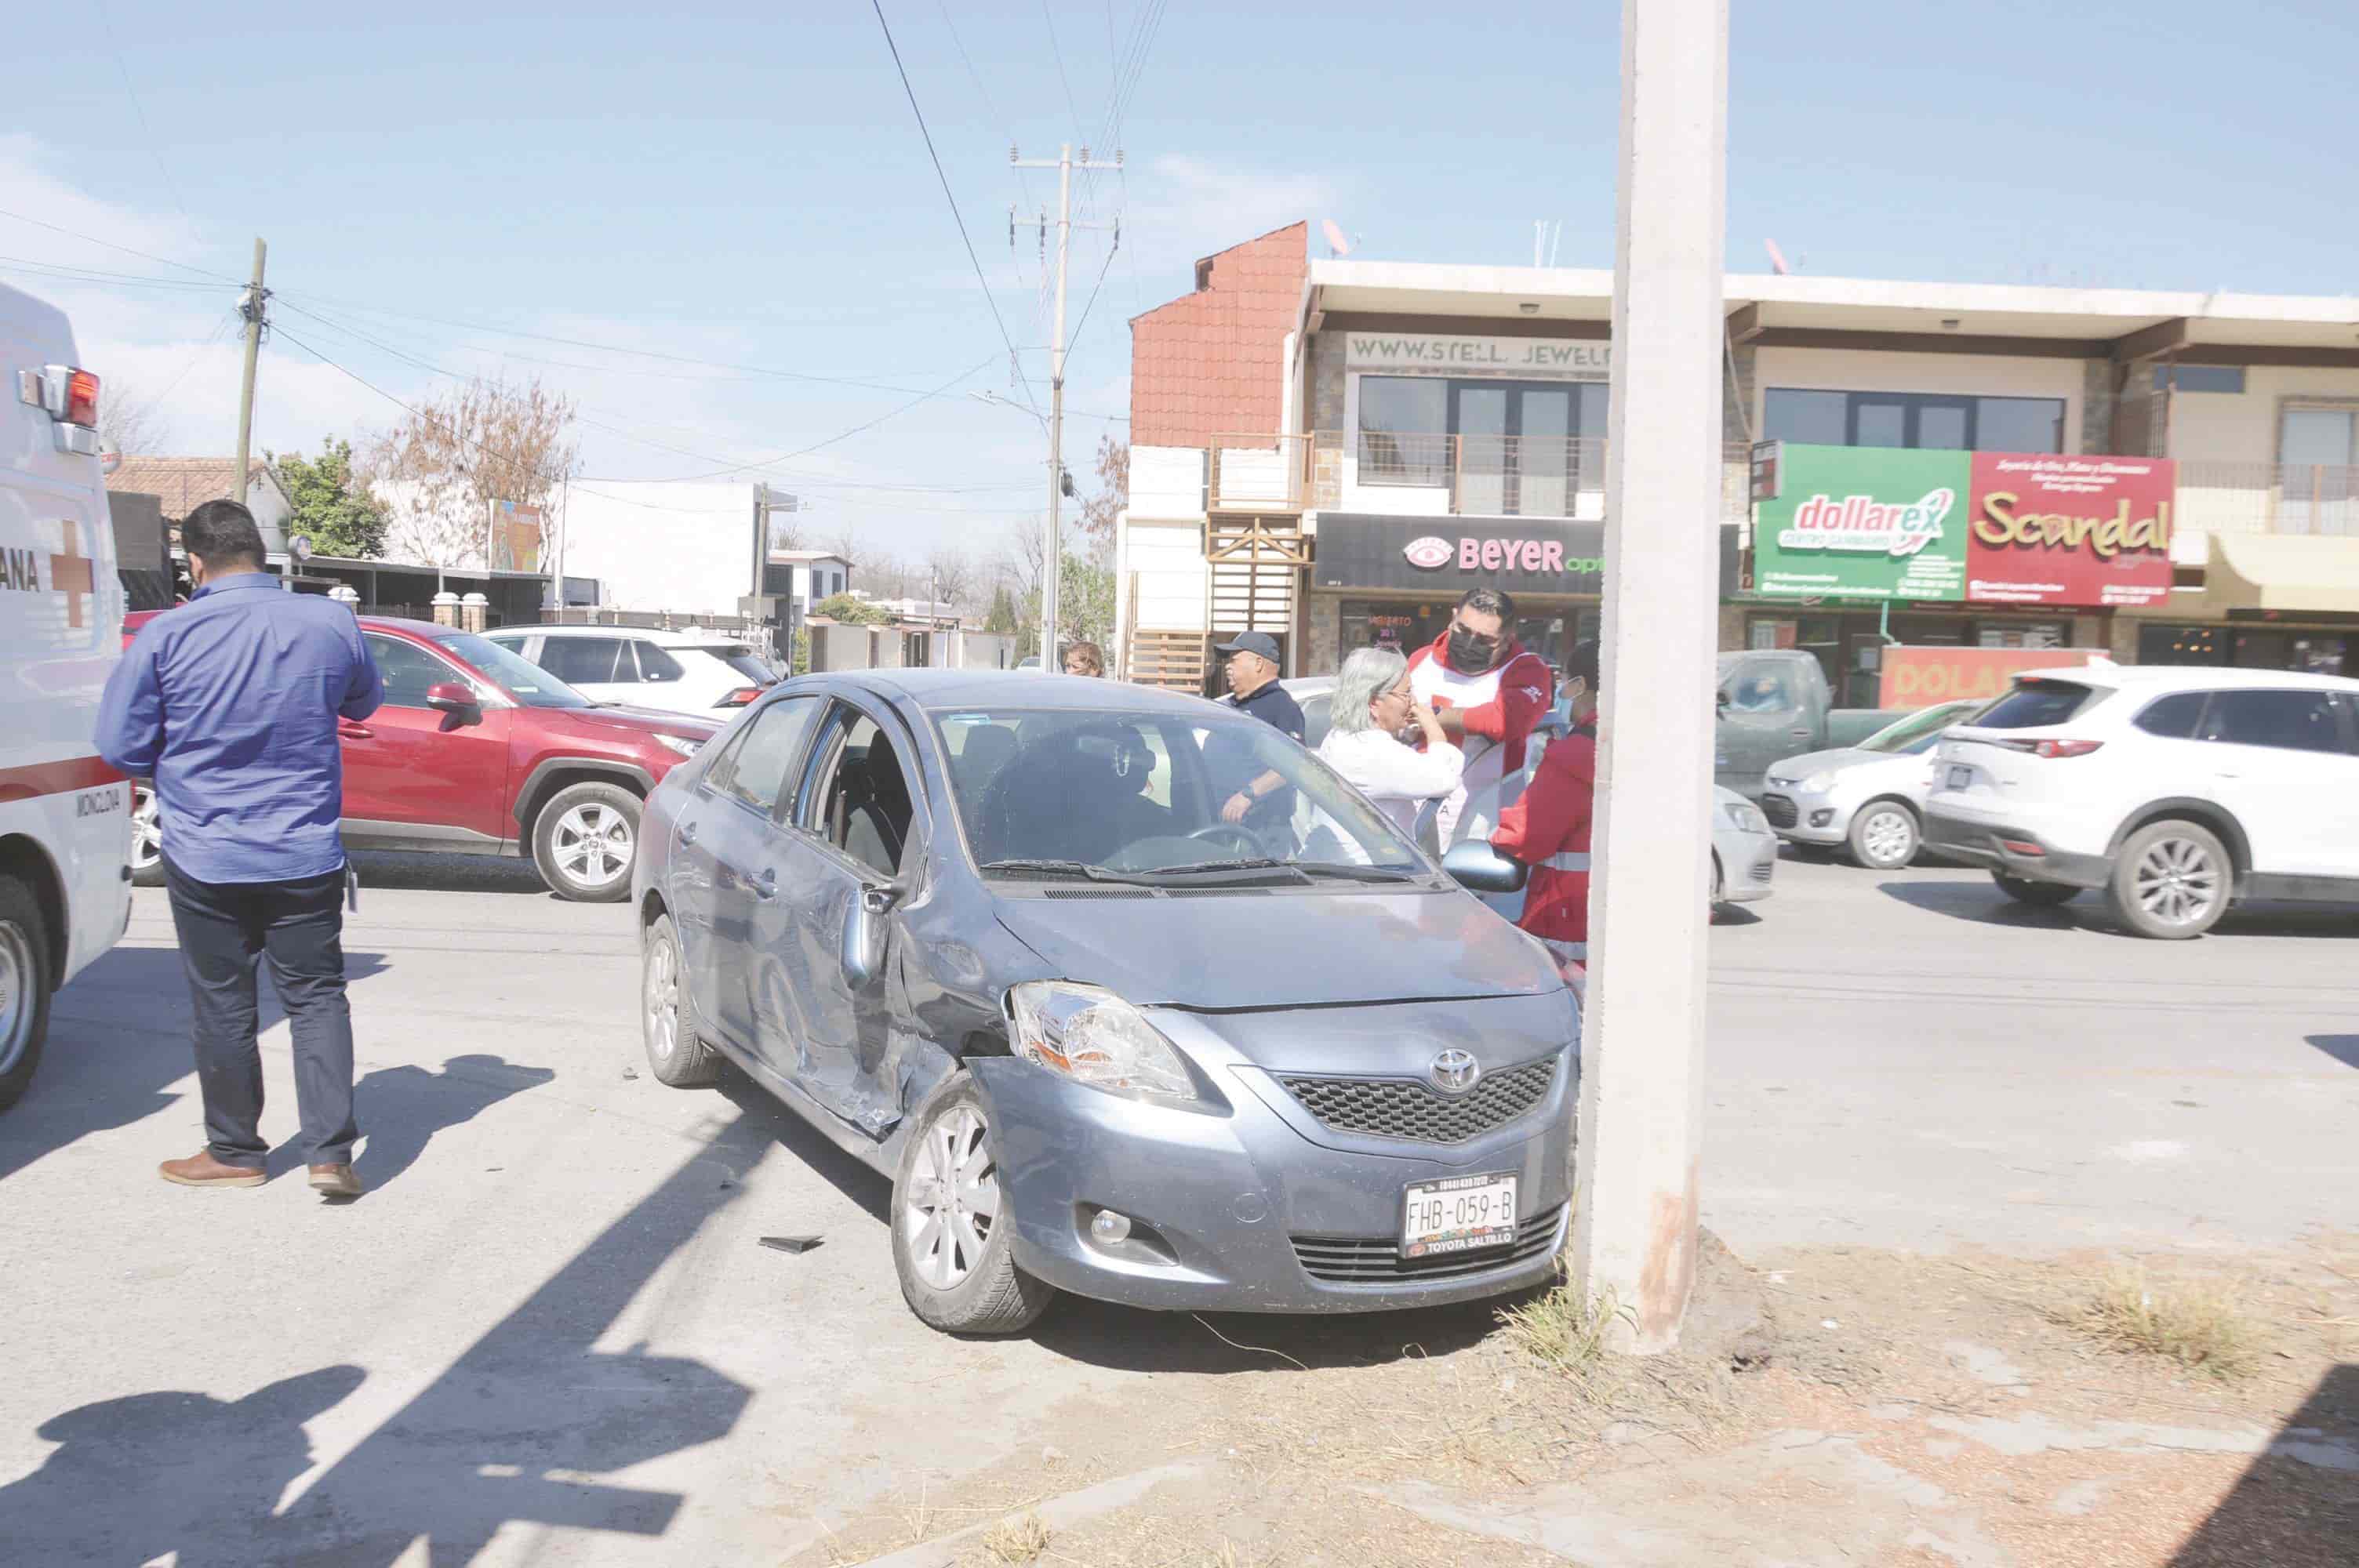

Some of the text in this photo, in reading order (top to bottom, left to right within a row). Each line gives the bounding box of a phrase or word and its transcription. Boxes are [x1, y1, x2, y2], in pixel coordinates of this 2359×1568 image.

[1798, 495, 1950, 533] dollarex
[1973, 491, 2170, 557] Scandal
[1407, 1190, 1513, 1235] FHB-059-B
[1428, 1239, 1467, 1254] TOYOTA
[1467, 1232, 1512, 1248] SALTILLO
